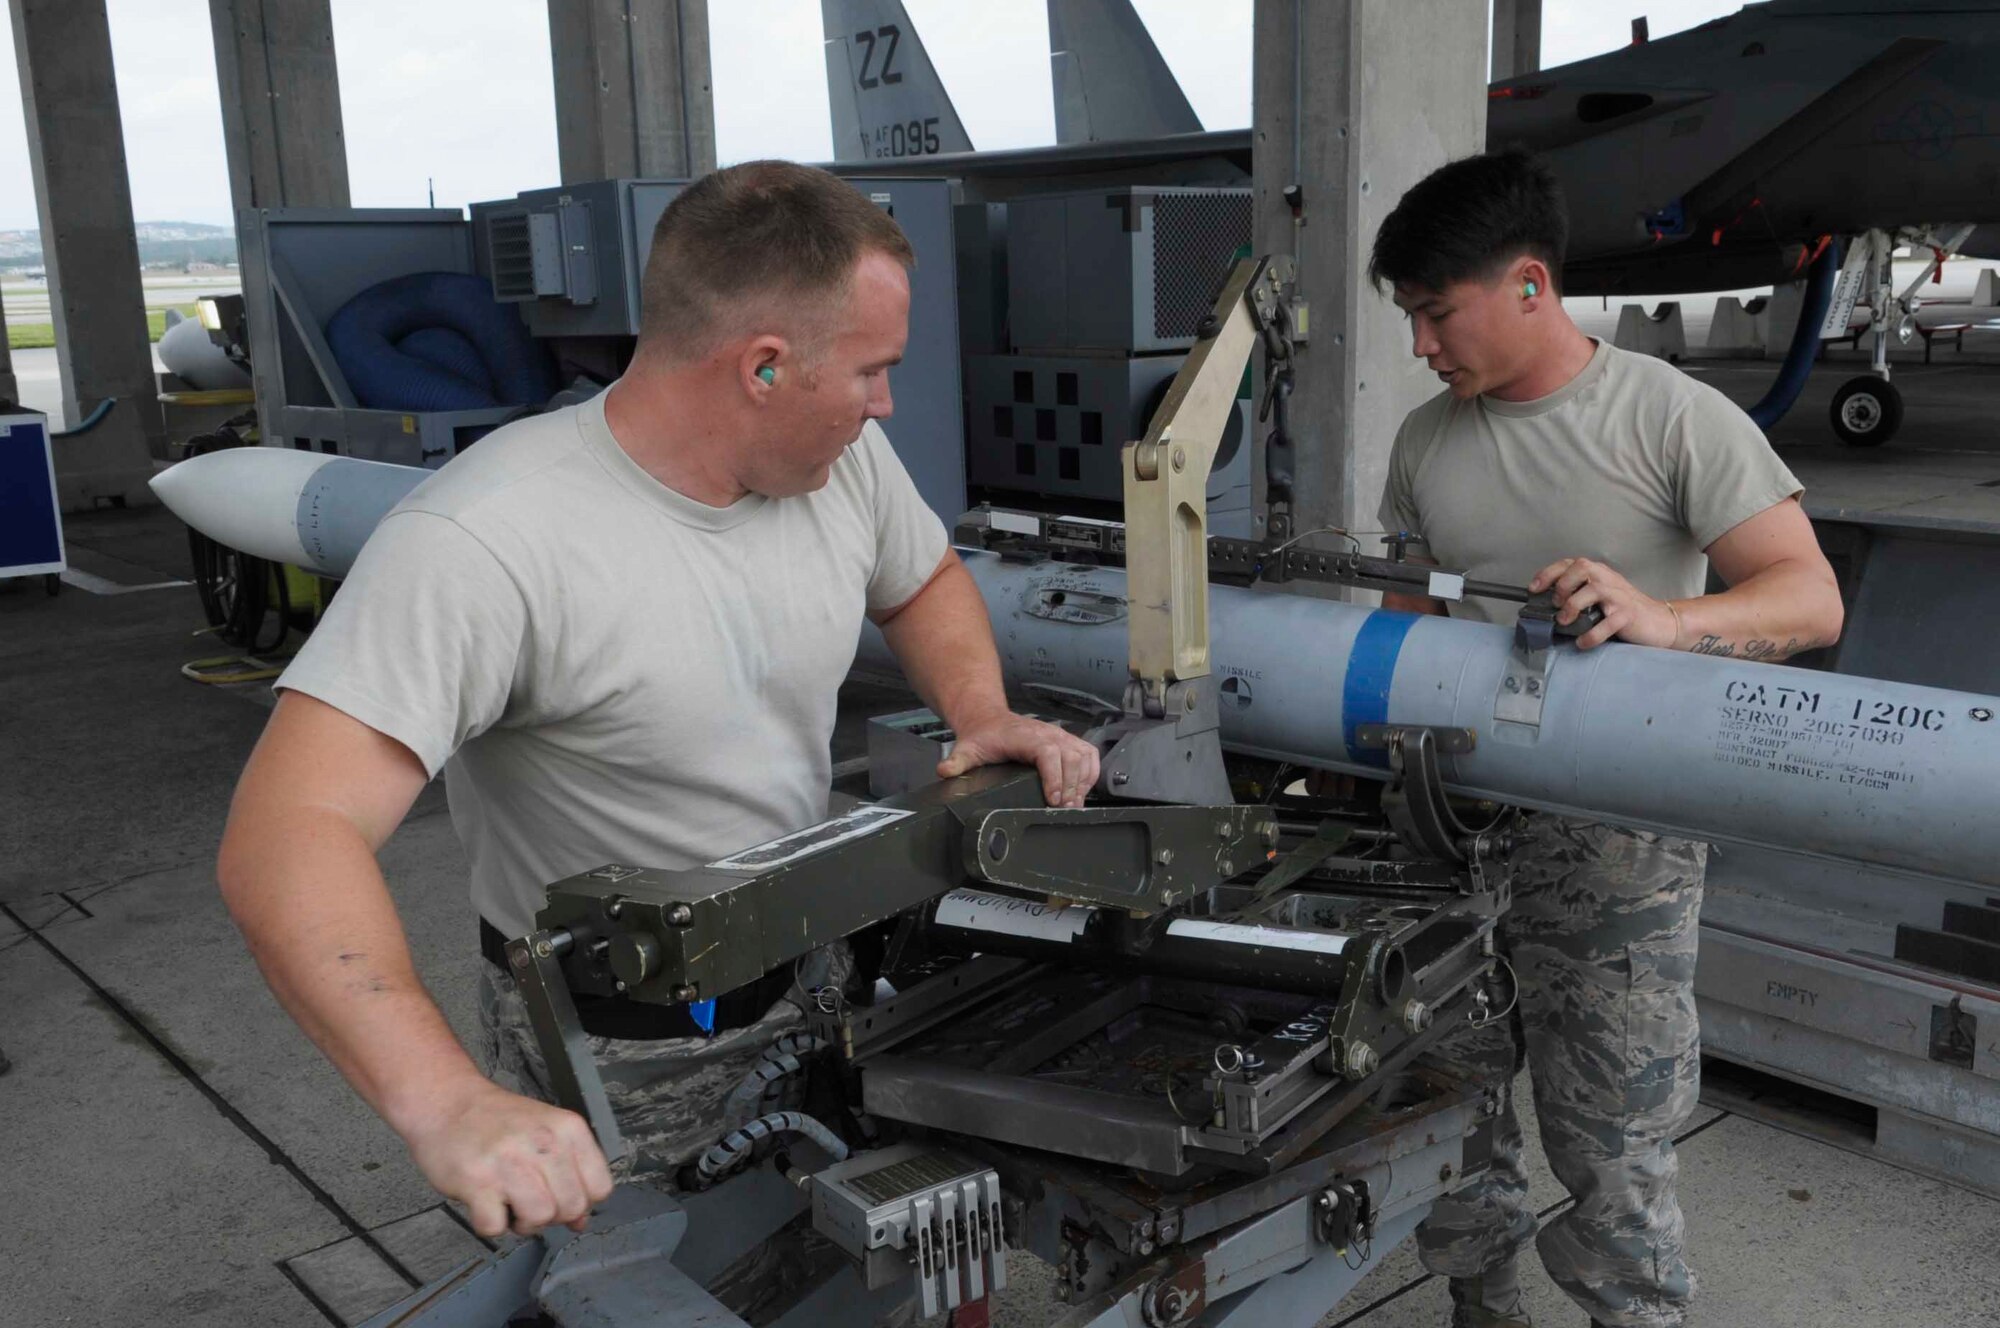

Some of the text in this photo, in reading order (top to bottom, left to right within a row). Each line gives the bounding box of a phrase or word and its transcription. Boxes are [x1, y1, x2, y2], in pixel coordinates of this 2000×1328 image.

[855, 24, 902, 90] ZZ
[891, 117, 940, 157] 095
[1219, 664, 1263, 680] MISSILE
[1721, 706, 1789, 729] SERNO
[1725, 680, 1946, 732] CATM 120C
[1766, 980, 1819, 1007] EMPTY
